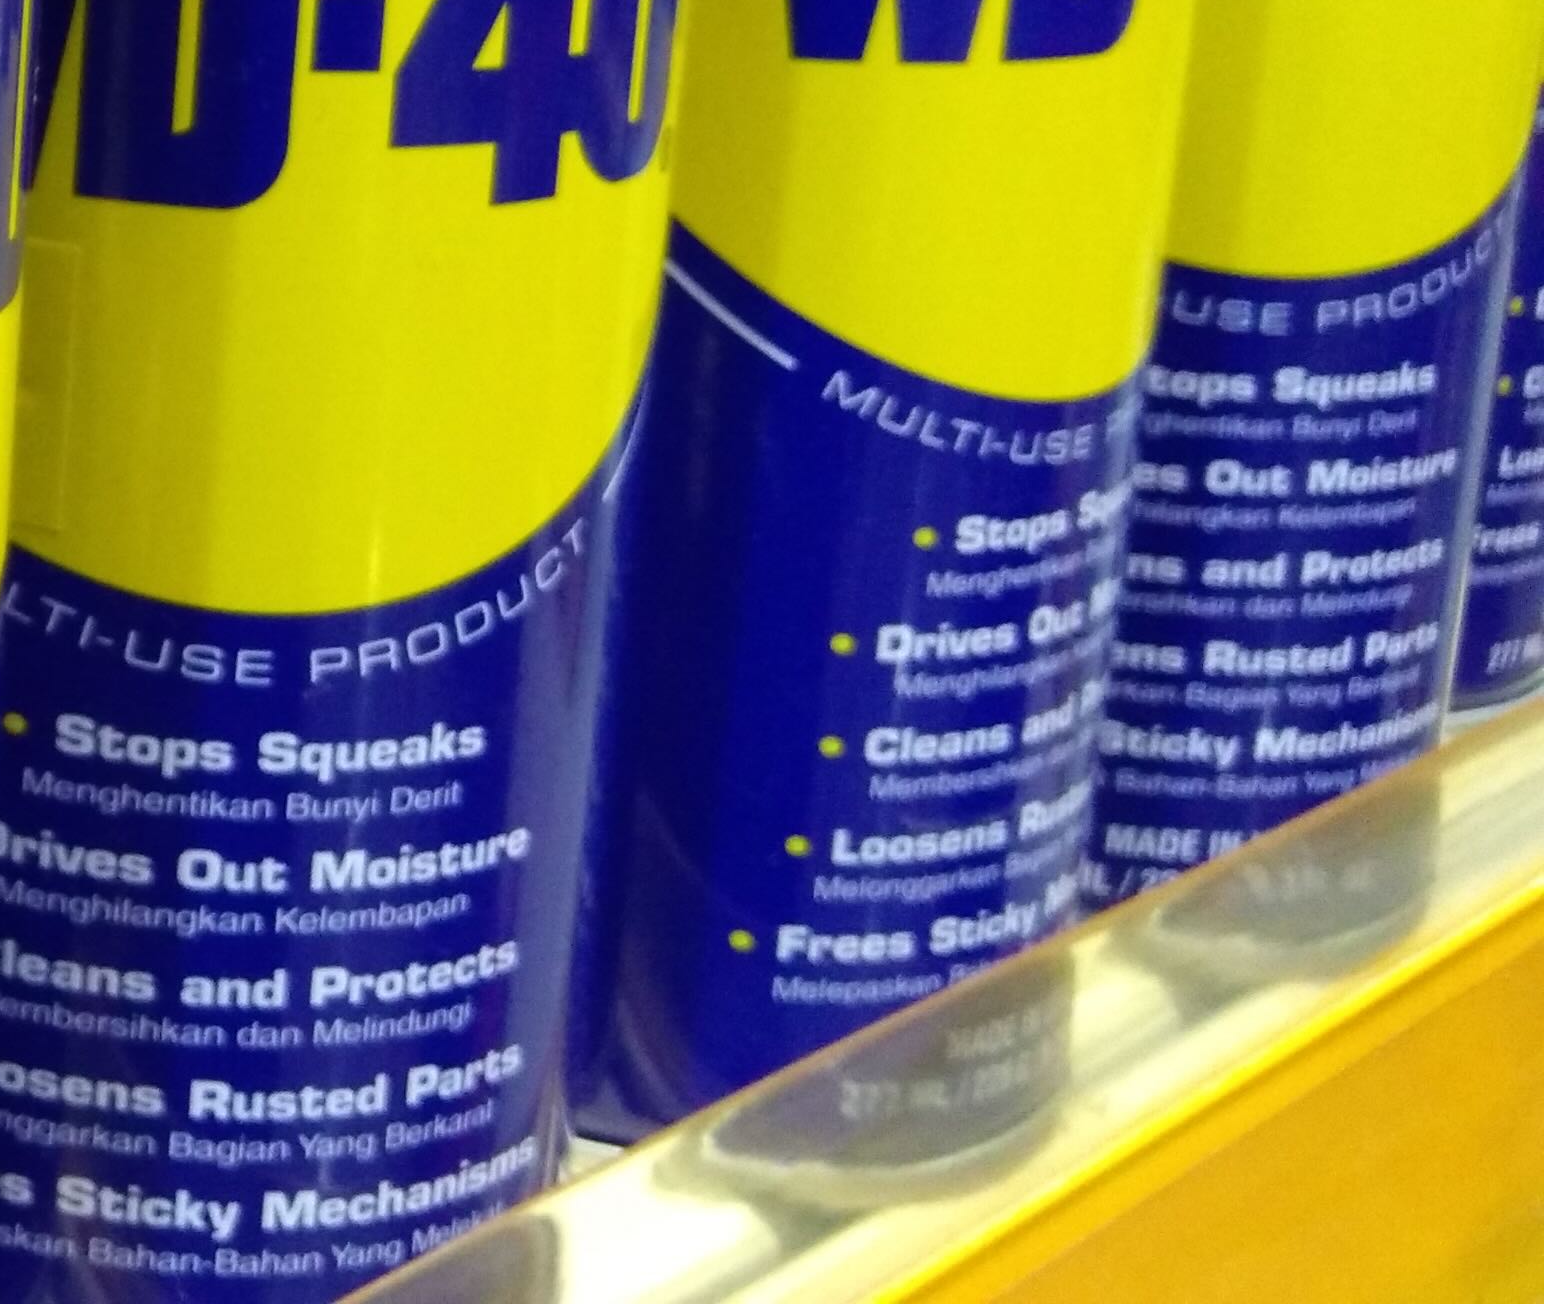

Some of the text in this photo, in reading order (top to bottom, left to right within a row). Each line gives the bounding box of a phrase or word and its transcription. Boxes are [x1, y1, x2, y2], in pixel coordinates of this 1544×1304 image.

[1144, 361, 1438, 411] tops Squeaks
[821, 369, 1096, 466] MULTI-USE
[1205, 458, 1292, 497] Out
[955, 509, 1069, 556] Stops
[1201, 552, 1289, 589] and
[2, 517, 589, 687] LTI-USE PRODUCT
[875, 622, 1020, 665] Drives
[1027, 599, 1085, 646] Out
[1203, 638, 1353, 677] Rusted
[54, 713, 486, 783] Stops Squeaks
[863, 722, 1013, 768] Cleans
[1020, 690, 1076, 745] and
[22, 766, 463, 824] Menghentikan Bunyi Derit
[176, 848, 287, 895] Out
[311, 825, 532, 894] Moisture
[830, 819, 1009, 868] Loosens
[1105, 822, 1202, 863] MADE
[275, 888, 471, 935] Kelembapan
[775, 902, 1038, 966] Frees Sticky
[180, 968, 289, 1011] and
[310, 938, 520, 1009] Protects
[237, 1009, 303, 1048] dan
[312, 999, 475, 1048] Melindungi
[188, 1076, 389, 1124] Rusted
[405, 1042, 523, 1107] Parts
[168, 1132, 292, 1167] Bagian
[298, 1132, 378, 1164] Yang
[56, 1174, 242, 1241] Sticky
[262, 1134, 538, 1232] Mechanisms
[331, 1239, 403, 1271] Yang
